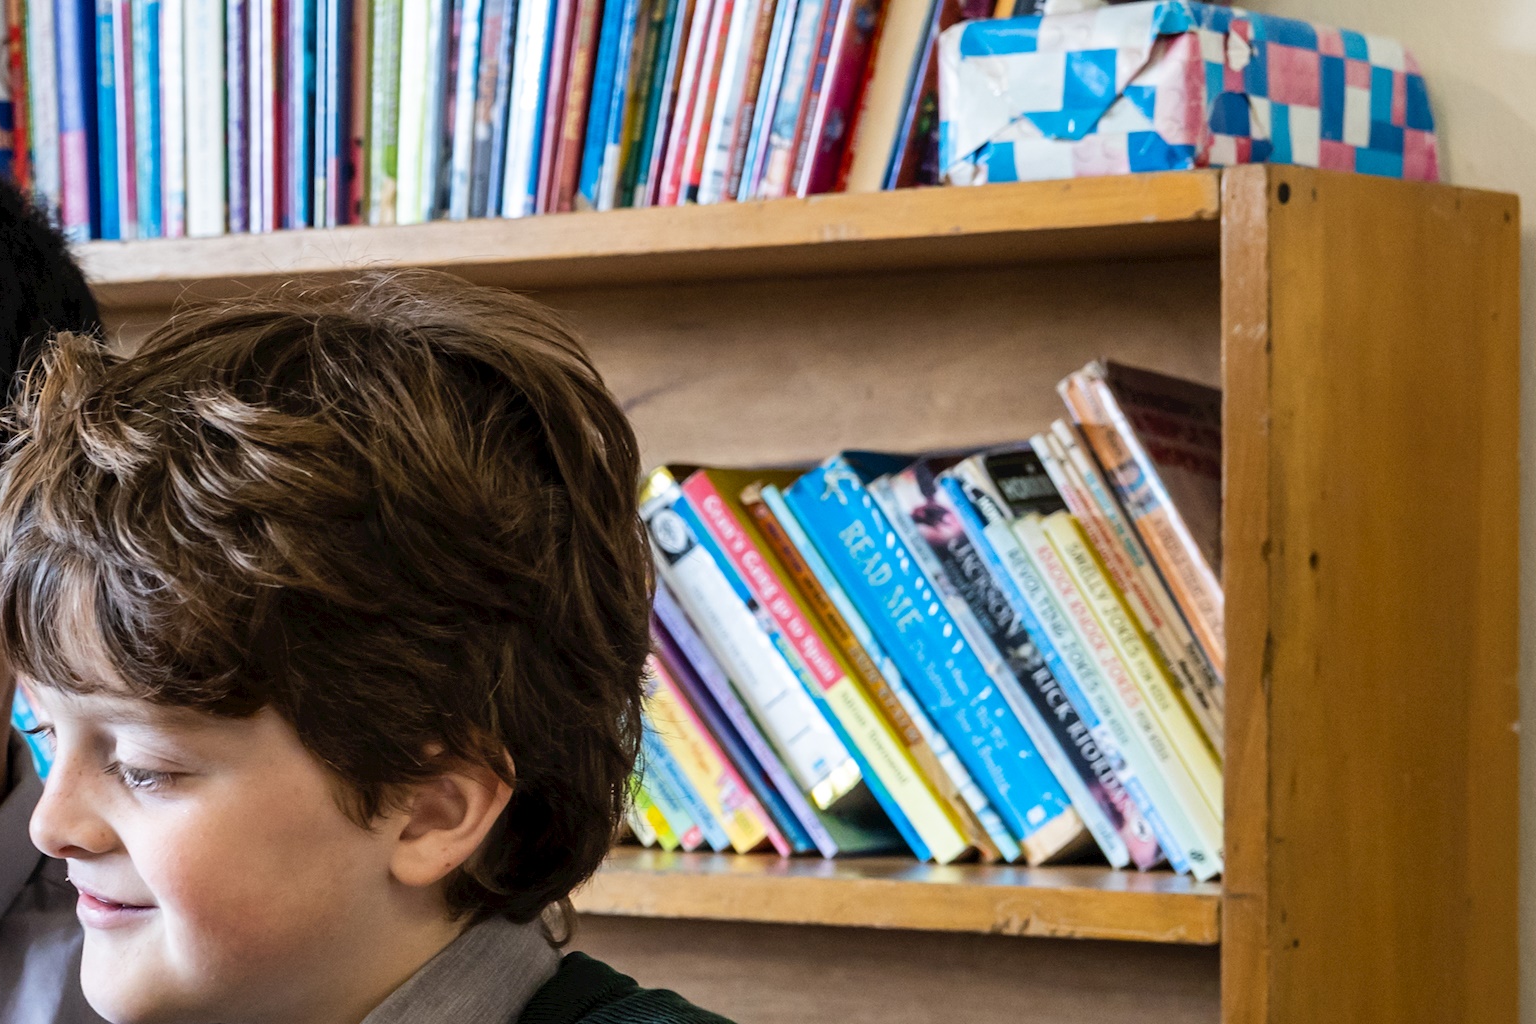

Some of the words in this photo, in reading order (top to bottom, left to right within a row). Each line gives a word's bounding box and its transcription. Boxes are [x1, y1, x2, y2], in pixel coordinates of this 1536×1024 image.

[699, 490, 750, 556] Gran's
[737, 546, 783, 602] Gang
[835, 515, 898, 592] READ
[878, 581, 926, 635] ME
[1061, 539, 1111, 604] SMELLY
[1099, 601, 1145, 660] JOKES
[767, 594, 795, 623] go
[786, 614, 811, 639] to
[1005, 546, 1070, 640] REVOLTING
[1061, 638, 1103, 694] JOKES
[1033, 541, 1078, 600] KNOCK
[1066, 595, 1110, 654] KNOCK
[1098, 651, 1146, 712] JOKES
[796, 631, 841, 685] Spain
[837, 687, 871, 729] Adrian
[1029, 664, 1076, 723] RICK
[1063, 718, 1136, 821] RIORDAN
